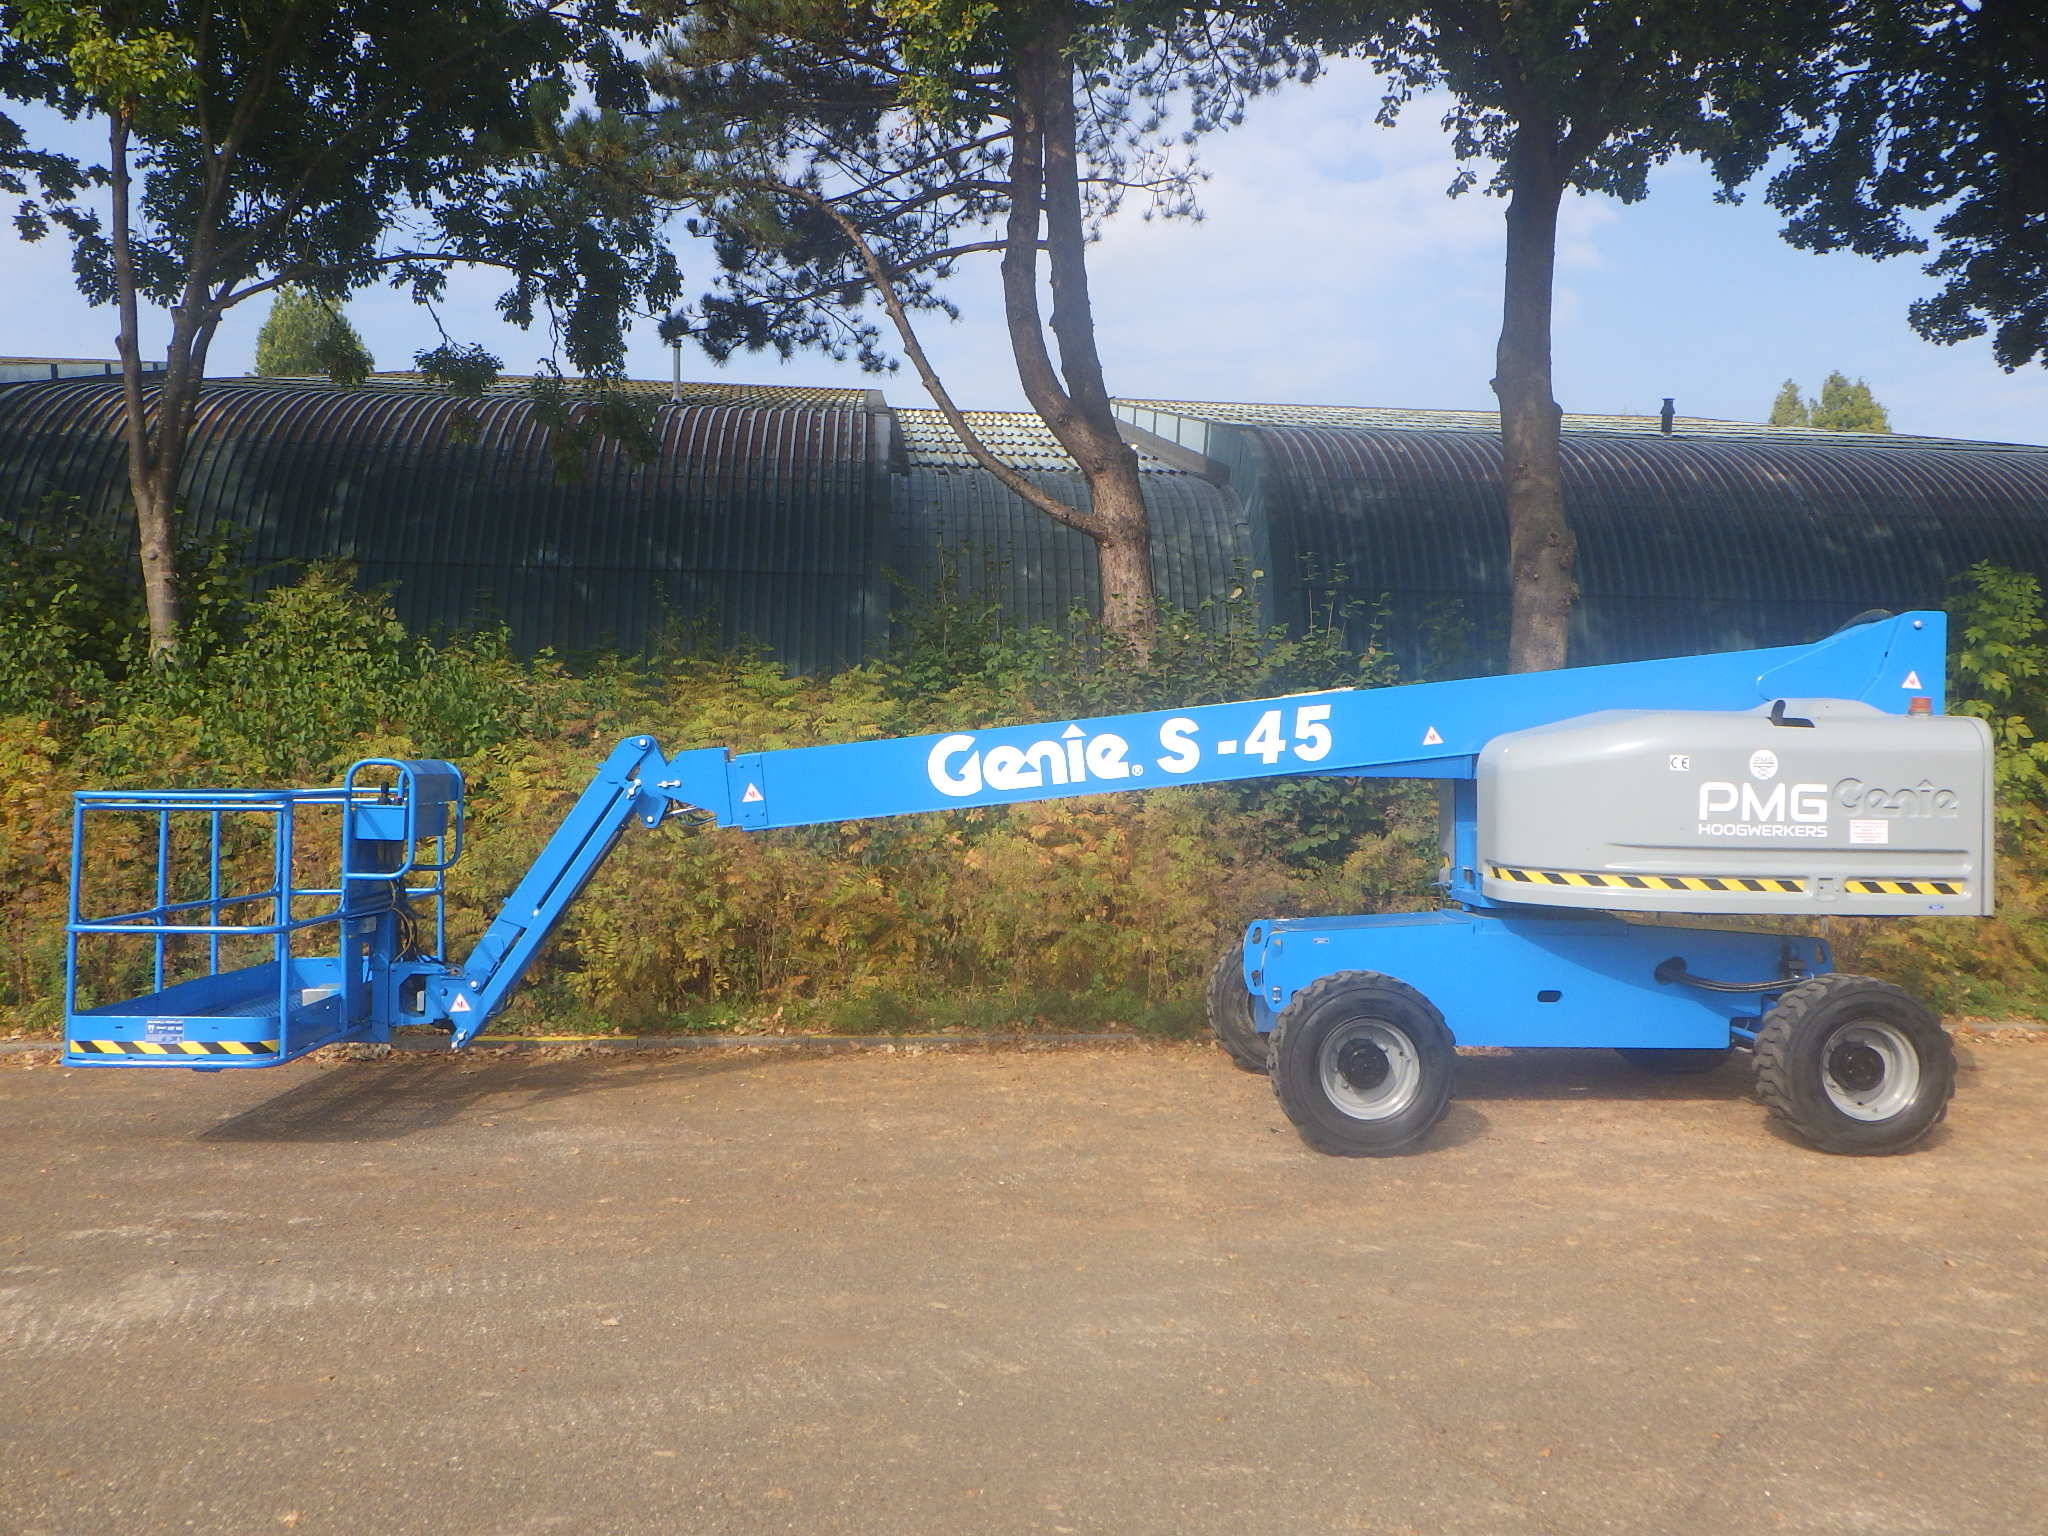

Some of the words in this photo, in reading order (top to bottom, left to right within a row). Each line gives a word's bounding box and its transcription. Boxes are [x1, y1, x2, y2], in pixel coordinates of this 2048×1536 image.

[927, 723, 1130, 797] Genie
[1670, 756, 1689, 770] CE
[1699, 781, 1828, 823] PMG
[1832, 777, 1960, 818] Genie
[1698, 824, 1828, 838] HOOGWERKERS
